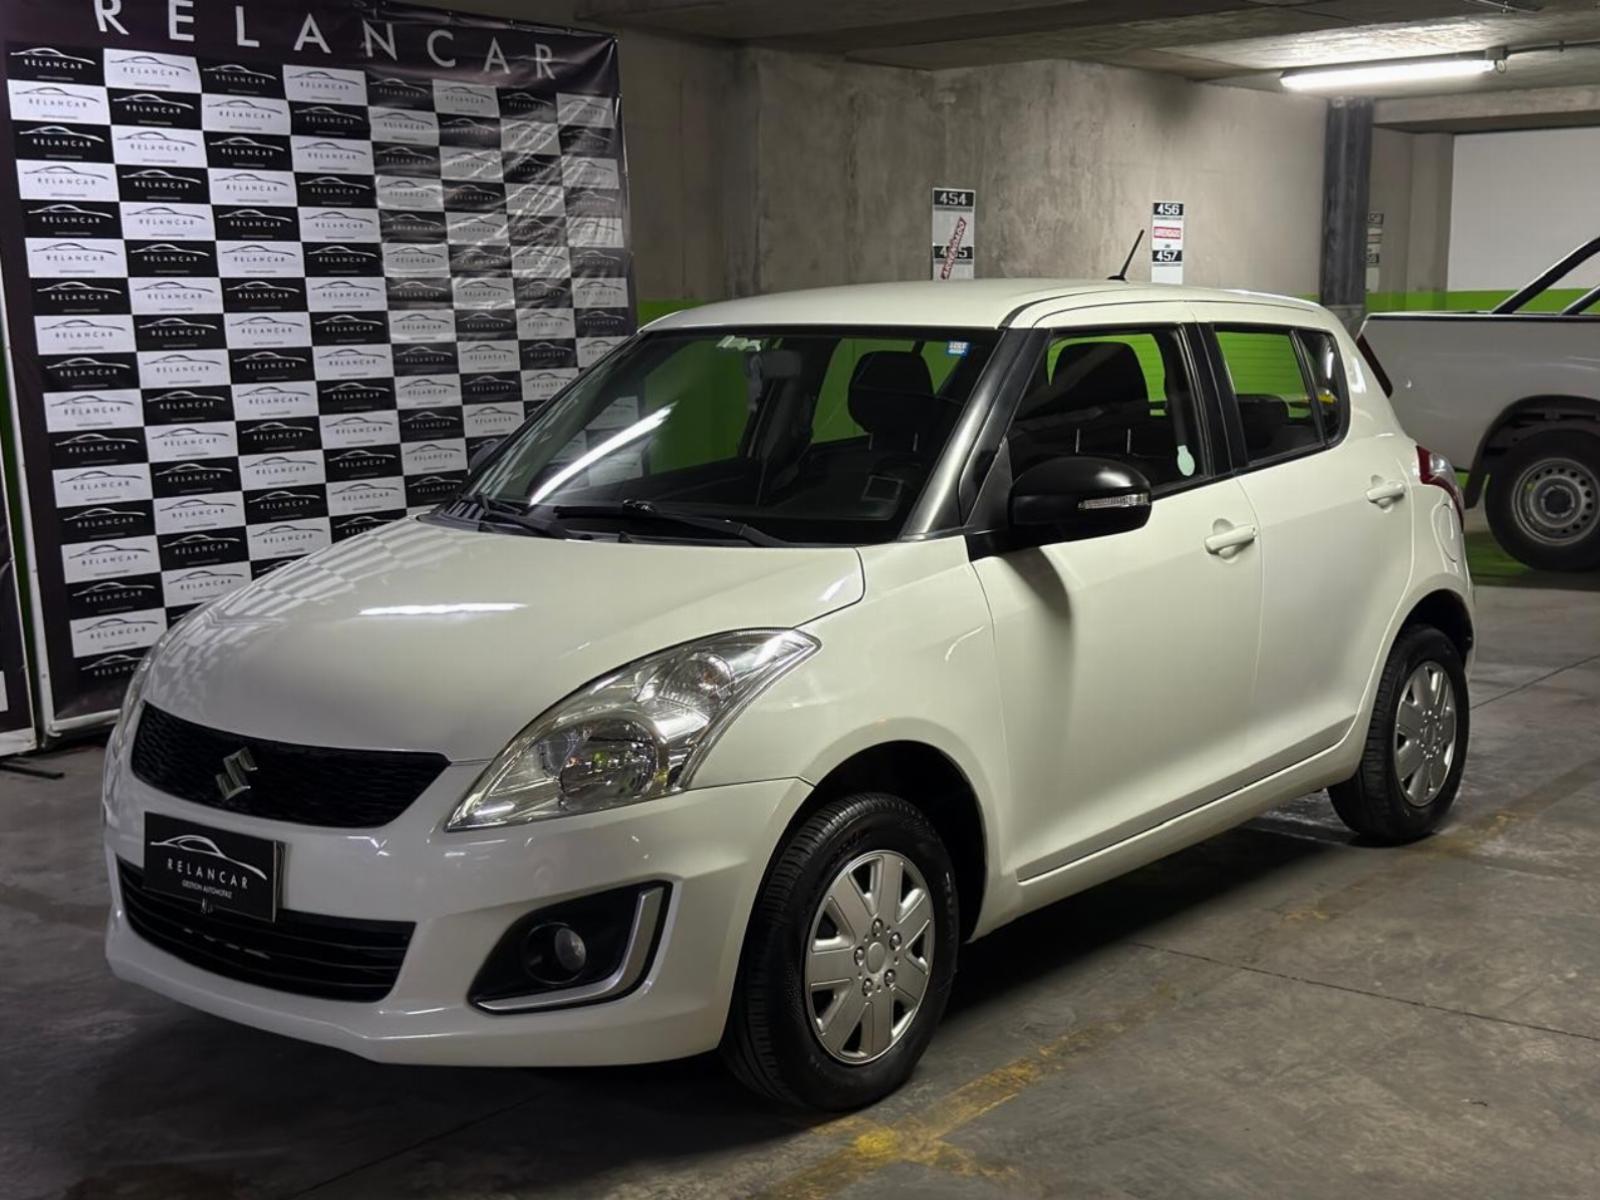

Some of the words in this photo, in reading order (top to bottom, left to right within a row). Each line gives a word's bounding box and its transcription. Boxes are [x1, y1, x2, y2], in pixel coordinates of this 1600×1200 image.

[95, 0, 556, 80] RELANCAR
[24, 59, 83, 70] RELANCAR
[122, 67, 180, 77] RELANCAR
[215, 75, 267, 85] RELANCAR
[300, 83, 349, 91] RELANCAR
[28, 99, 88, 108] RELANCAR
[126, 105, 182, 115] RELANCAR
[219, 111, 271, 120] RELANCAR
[304, 117, 354, 126] RELANCAR
[33, 138, 92, 147] RELANCAR
[130, 143, 186, 152] RELANCAR
[222, 148, 274, 157] RELANCAR
[307, 153, 357, 161] RELANCAR
[37, 177, 96, 186] RELANCAR
[134, 181, 190, 189] RELANCAR
[226, 184, 278, 192] RELANCAR
[311, 187, 360, 195] RELANCAR
[940, 192, 967, 205] 454
[1157, 203, 1180, 215] 456
[42, 216, 101, 224] RELANCAR
[139, 218, 194, 226] RELANCAR
[230, 220, 282, 228] RELANCAR
[940, 246, 968, 258] 45
[1156, 250, 1178, 262] 457
[50, 293, 110, 301] RELANCAR
[55, 331, 114, 339] RELANCAR
[245, 362, 297, 370] RELANCAR
[329, 358, 377, 366] RELANCAR
[59, 369, 118, 377] RELANCAR
[156, 365, 210, 373] RELANCAR
[249, 396, 300, 405] RELANCAR
[332, 392, 380, 400] RELANCAR
[159, 401, 214, 410] RELANCAR
[64, 406, 122, 415] RELANCAR
[336, 425, 383, 434] RELANCAR
[253, 431, 304, 440] RELANCAR
[163, 437, 218, 446] RELANCAR
[68, 443, 126, 453] RELANCAR
[339, 458, 387, 468] RELANCAR
[256, 466, 307, 475] RELANCAR
[168, 473, 222, 483] RELANCAR
[72, 480, 131, 491] RELANCAR
[342, 490, 389, 500] RELANCAR
[259, 499, 311, 510] RELANCAR
[172, 508, 226, 519] RELANCAR
[77, 517, 135, 528] RELANCAR
[262, 533, 314, 544] RELANCAR
[175, 543, 229, 555] RELANCAR
[81, 554, 139, 566] RELANCAR
[180, 578, 232, 591] RELANCAR
[85, 590, 143, 603] RELANCAR
[90, 626, 147, 640] RELANCAR
[167, 858, 248, 889] RELANCAR
